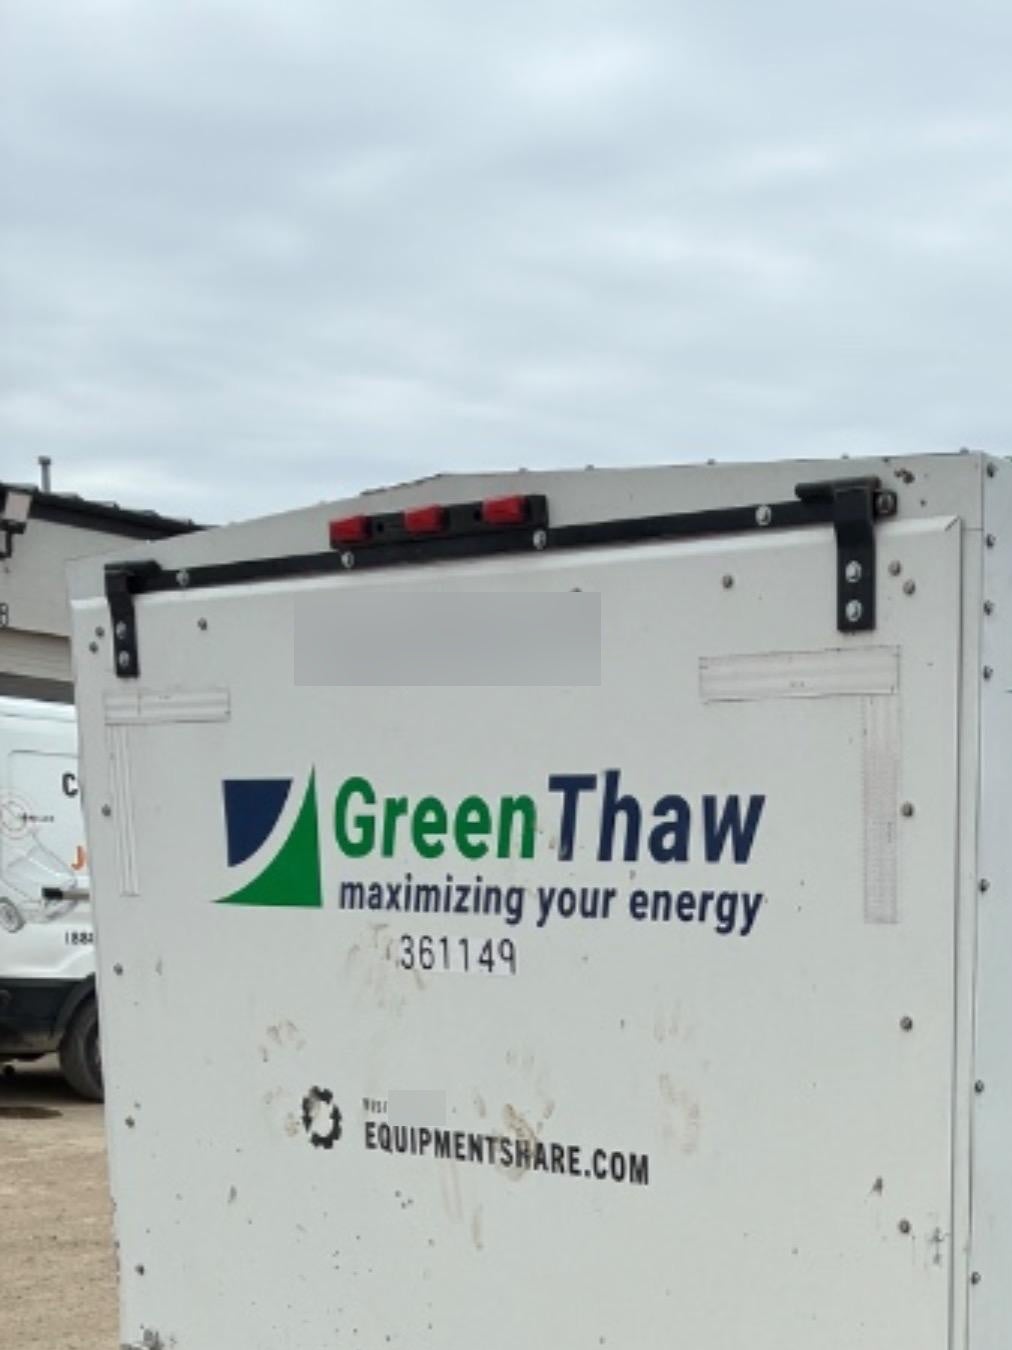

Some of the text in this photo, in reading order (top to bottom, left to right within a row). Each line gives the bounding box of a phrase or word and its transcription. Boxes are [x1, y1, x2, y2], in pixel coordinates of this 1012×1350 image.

[334, 769, 766, 865] GreenThaw
[338, 873, 763, 937] maximizing your energy
[399, 933, 518, 976] 361149
[364, 1120, 650, 1187] EQUIPMENTSHARE.COM
